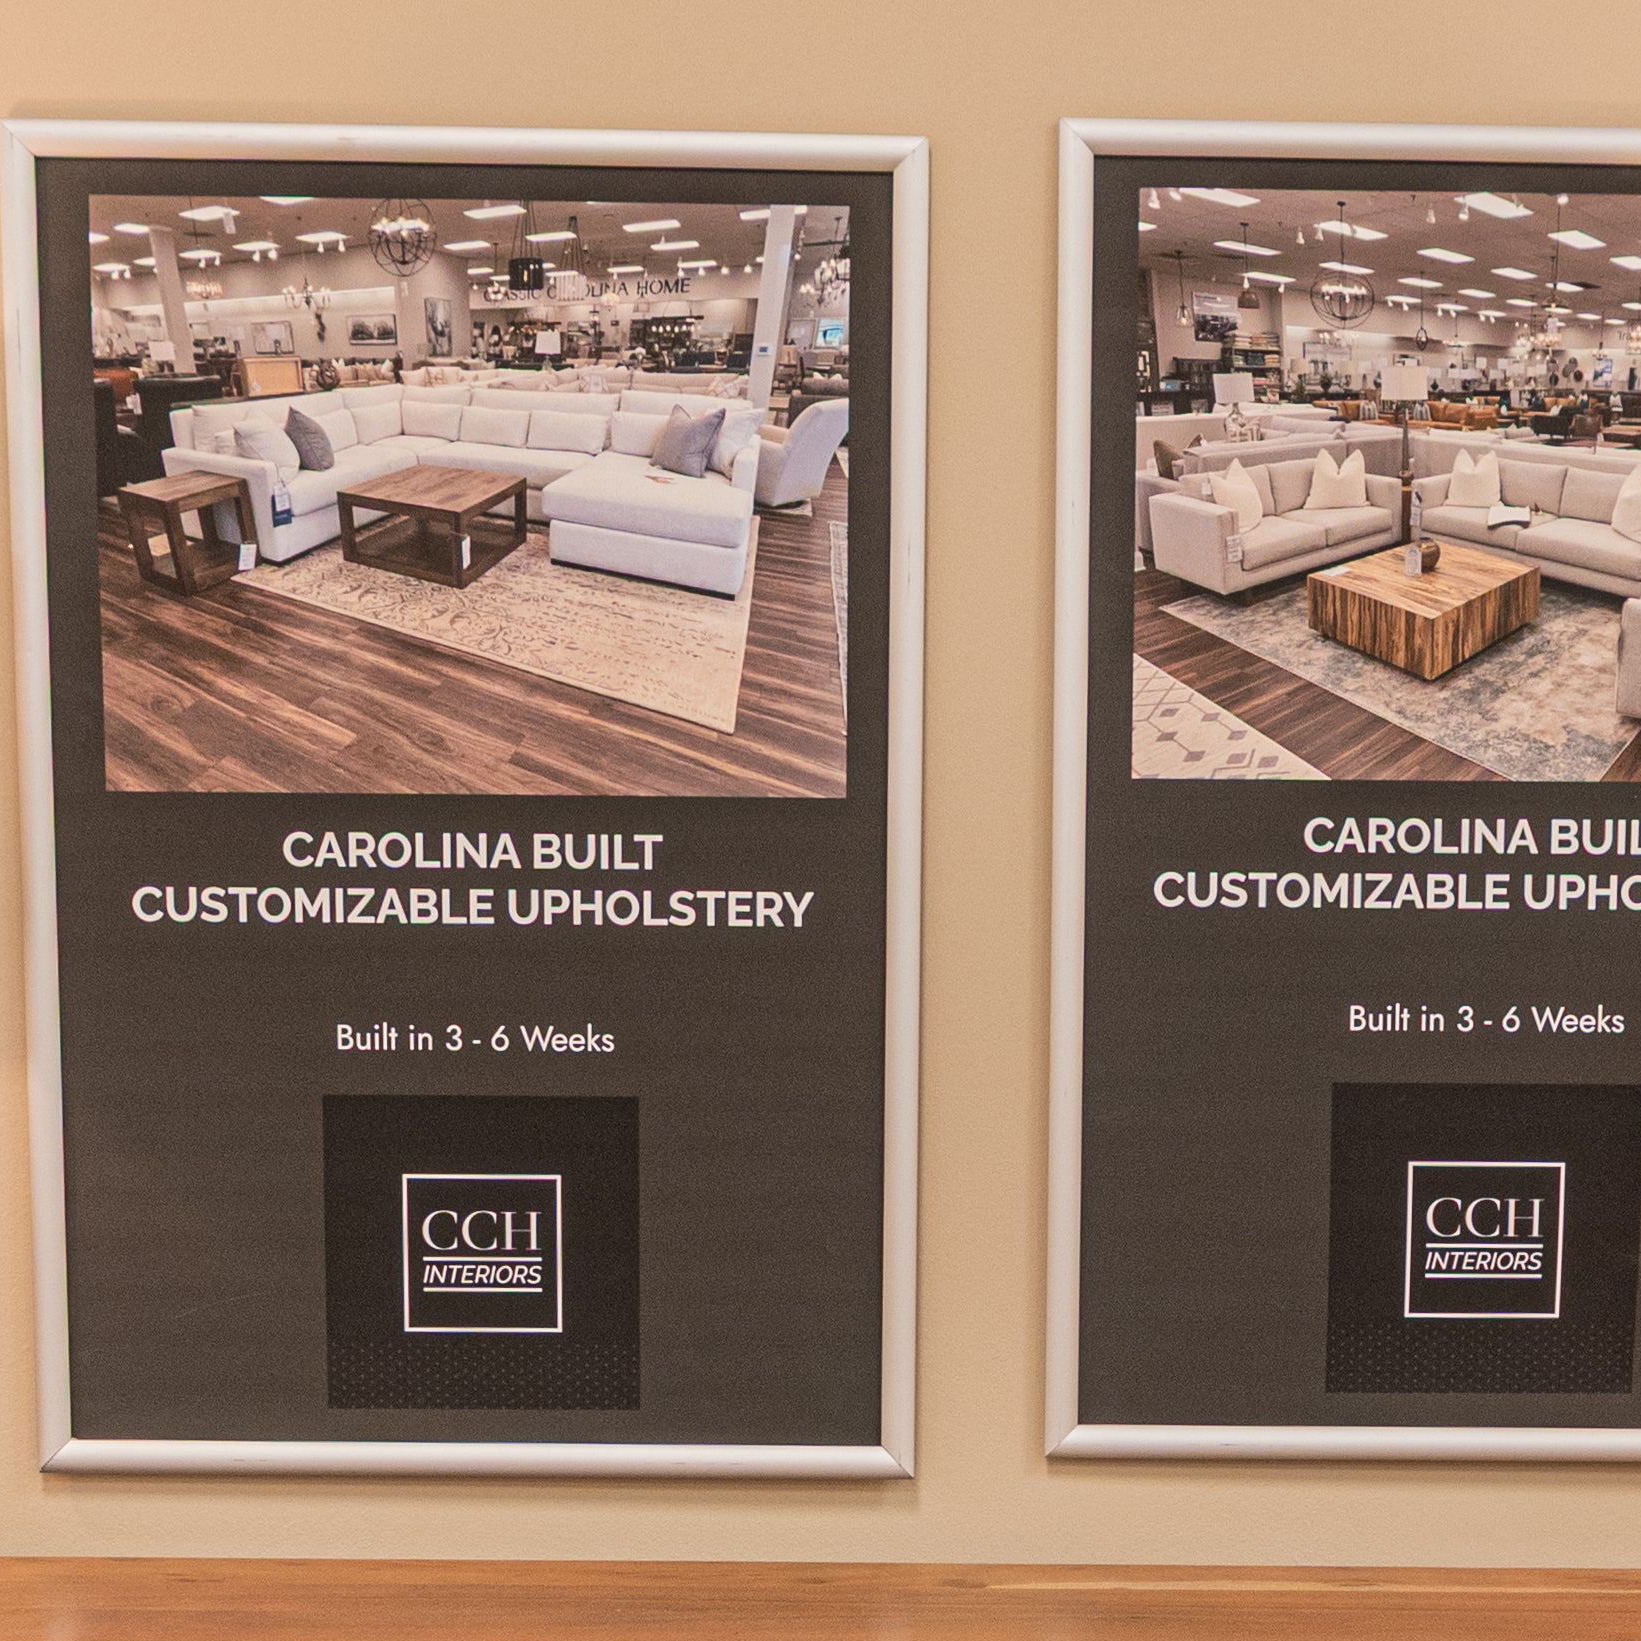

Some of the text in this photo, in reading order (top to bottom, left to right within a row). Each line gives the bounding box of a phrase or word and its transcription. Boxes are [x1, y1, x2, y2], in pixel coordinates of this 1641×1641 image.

[637, 278, 691, 296] HOME
[283, 831, 665, 872] CAROLINA BUILT
[1304, 817, 1540, 856] CAROLINA
[132, 886, 816, 929] CUSTOMIZABLE UPHOLSTERY
[1154, 872, 1512, 911] CUSTOMIZABLE
[337, 1022, 400, 1052] Built
[409, 1025, 434, 1052] in
[446, 1025, 464, 1053] 3
[491, 1026, 511, 1053] 6
[520, 1023, 616, 1054] Weeks
[1350, 1003, 1412, 1033] Built
[1421, 1006, 1446, 1033] in
[1457, 1006, 1475, 1034] 3
[1502, 1006, 1522, 1034] 6
[1531, 1004, 1626, 1035] Weeks
[422, 1209, 543, 1252] CCH
[1426, 1197, 1545, 1239] CCH
[423, 1264, 543, 1286] INTERIORS
[1425, 1251, 1543, 1272] INTERIORS
